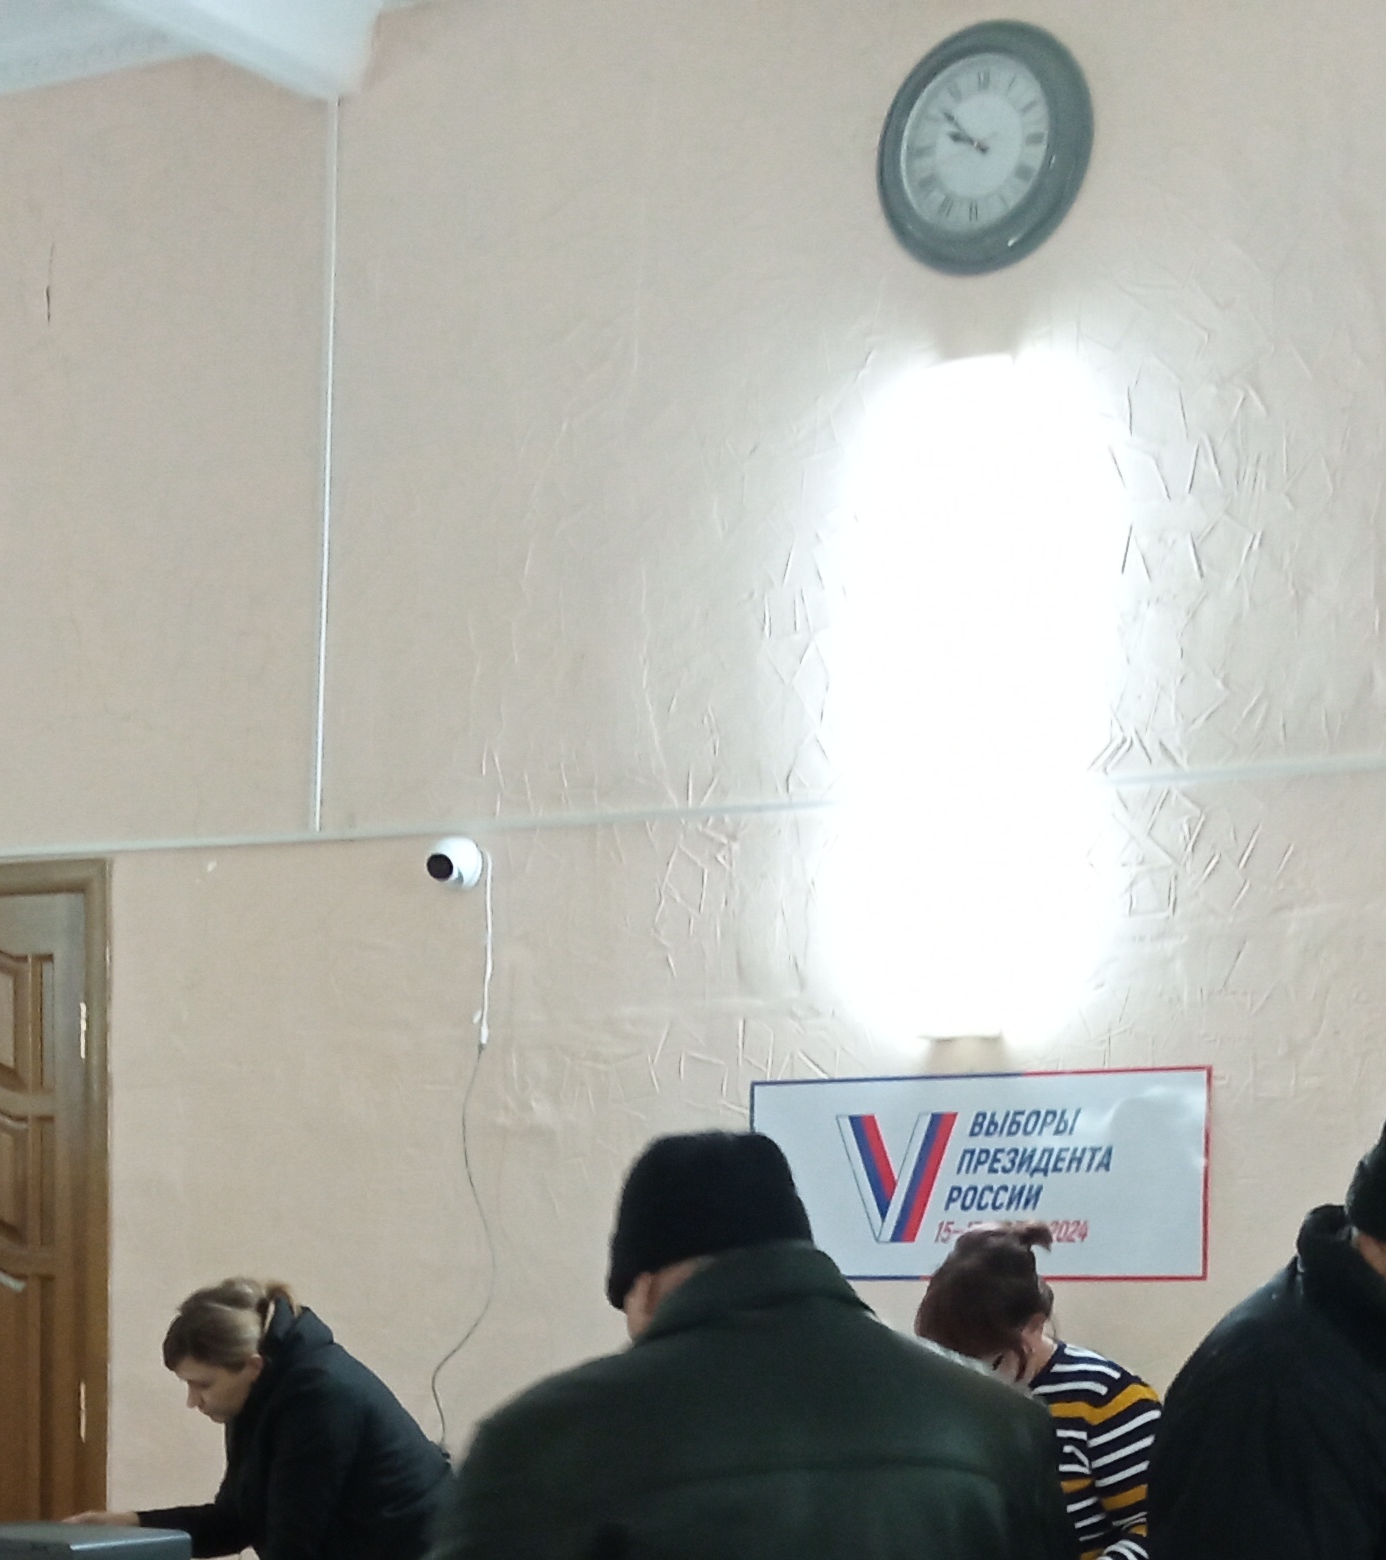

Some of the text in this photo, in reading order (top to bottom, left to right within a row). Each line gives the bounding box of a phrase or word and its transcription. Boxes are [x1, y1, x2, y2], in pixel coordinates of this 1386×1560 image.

[969, 1108, 1081, 1137] ВЫБОРЫ
[957, 1145, 1114, 1177] ПРЕЗИДЕНТА
[944, 1184, 1043, 1211] РОССИИ
